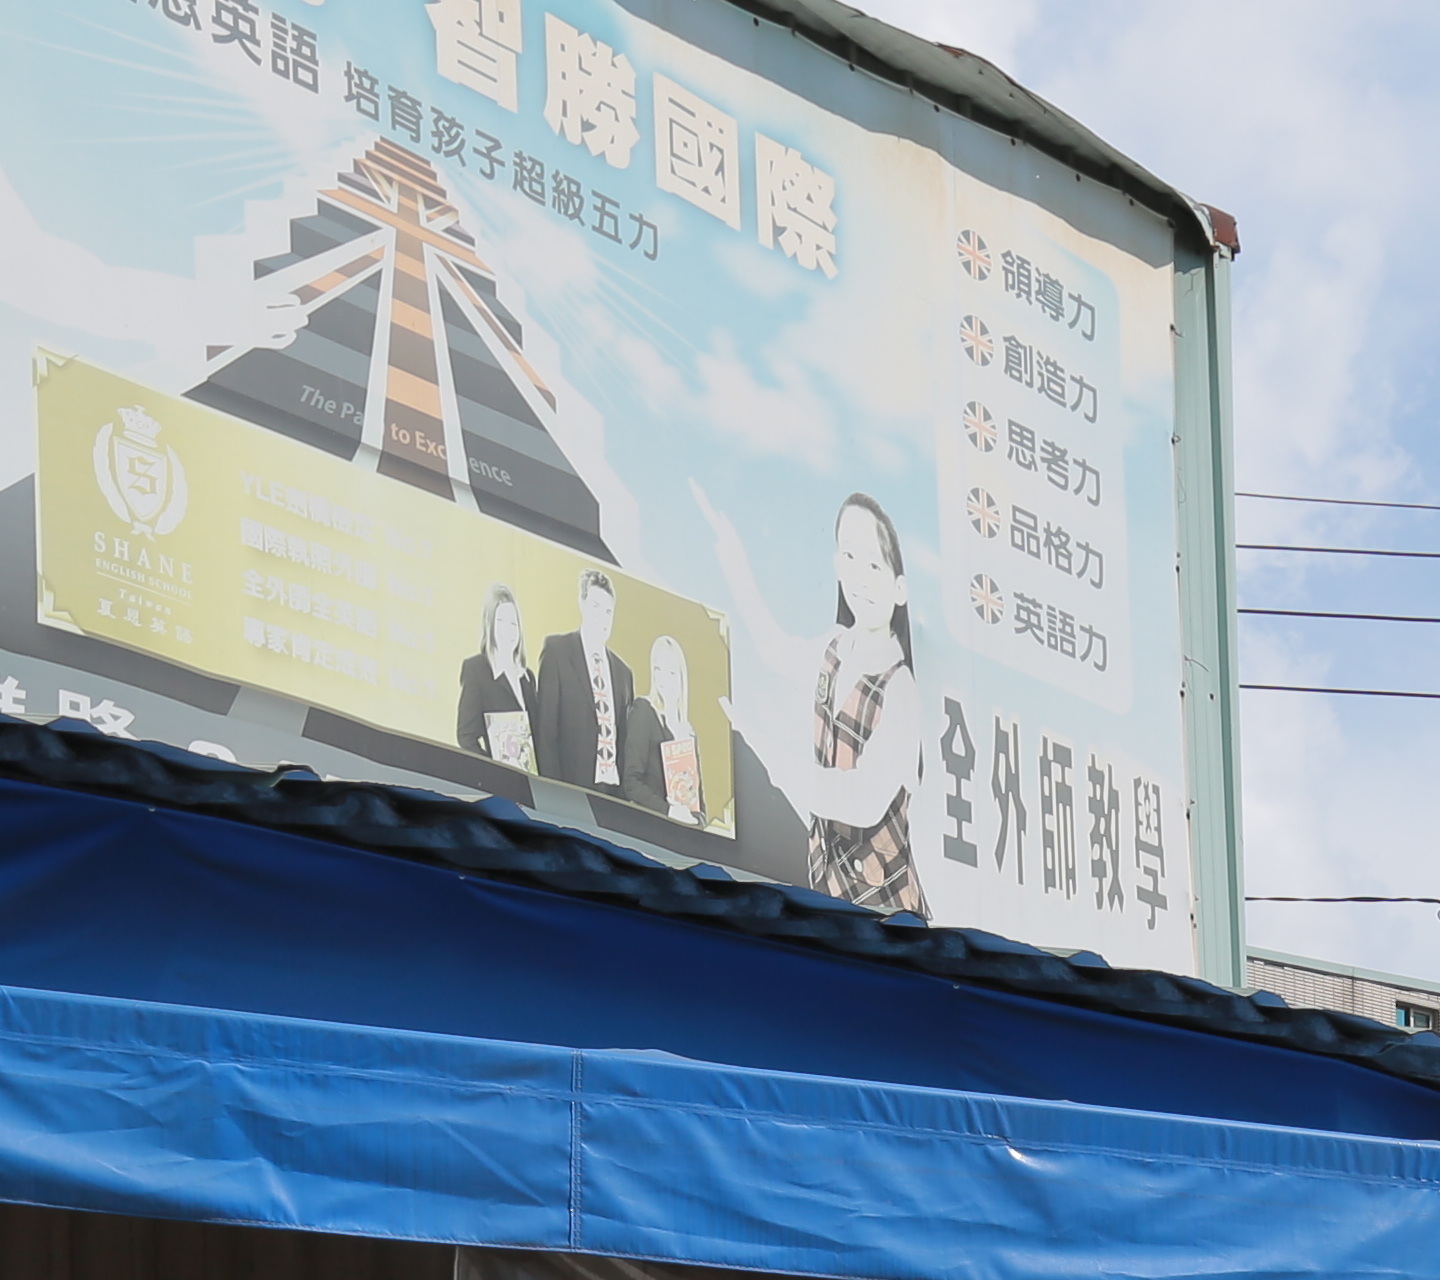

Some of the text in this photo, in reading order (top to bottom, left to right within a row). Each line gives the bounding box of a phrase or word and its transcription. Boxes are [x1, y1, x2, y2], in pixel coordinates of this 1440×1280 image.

[128, 0, 661, 262] 英語 培育孩子超級五力
[425, 0, 842, 279] 智勝國際
[1000, 249, 1098, 342] 領導力
[300, 385, 412, 446] The to
[1002, 335, 1100, 425] 創造力
[1006, 418, 1102, 507] 思考力
[94, 531, 193, 584] SHANE
[95, 558, 193, 600] ENGLISH SCHOOL
[1009, 504, 1105, 590] 品格力
[1013, 592, 1108, 672] 英語力
[940, 695, 1168, 930] 全外師教學
